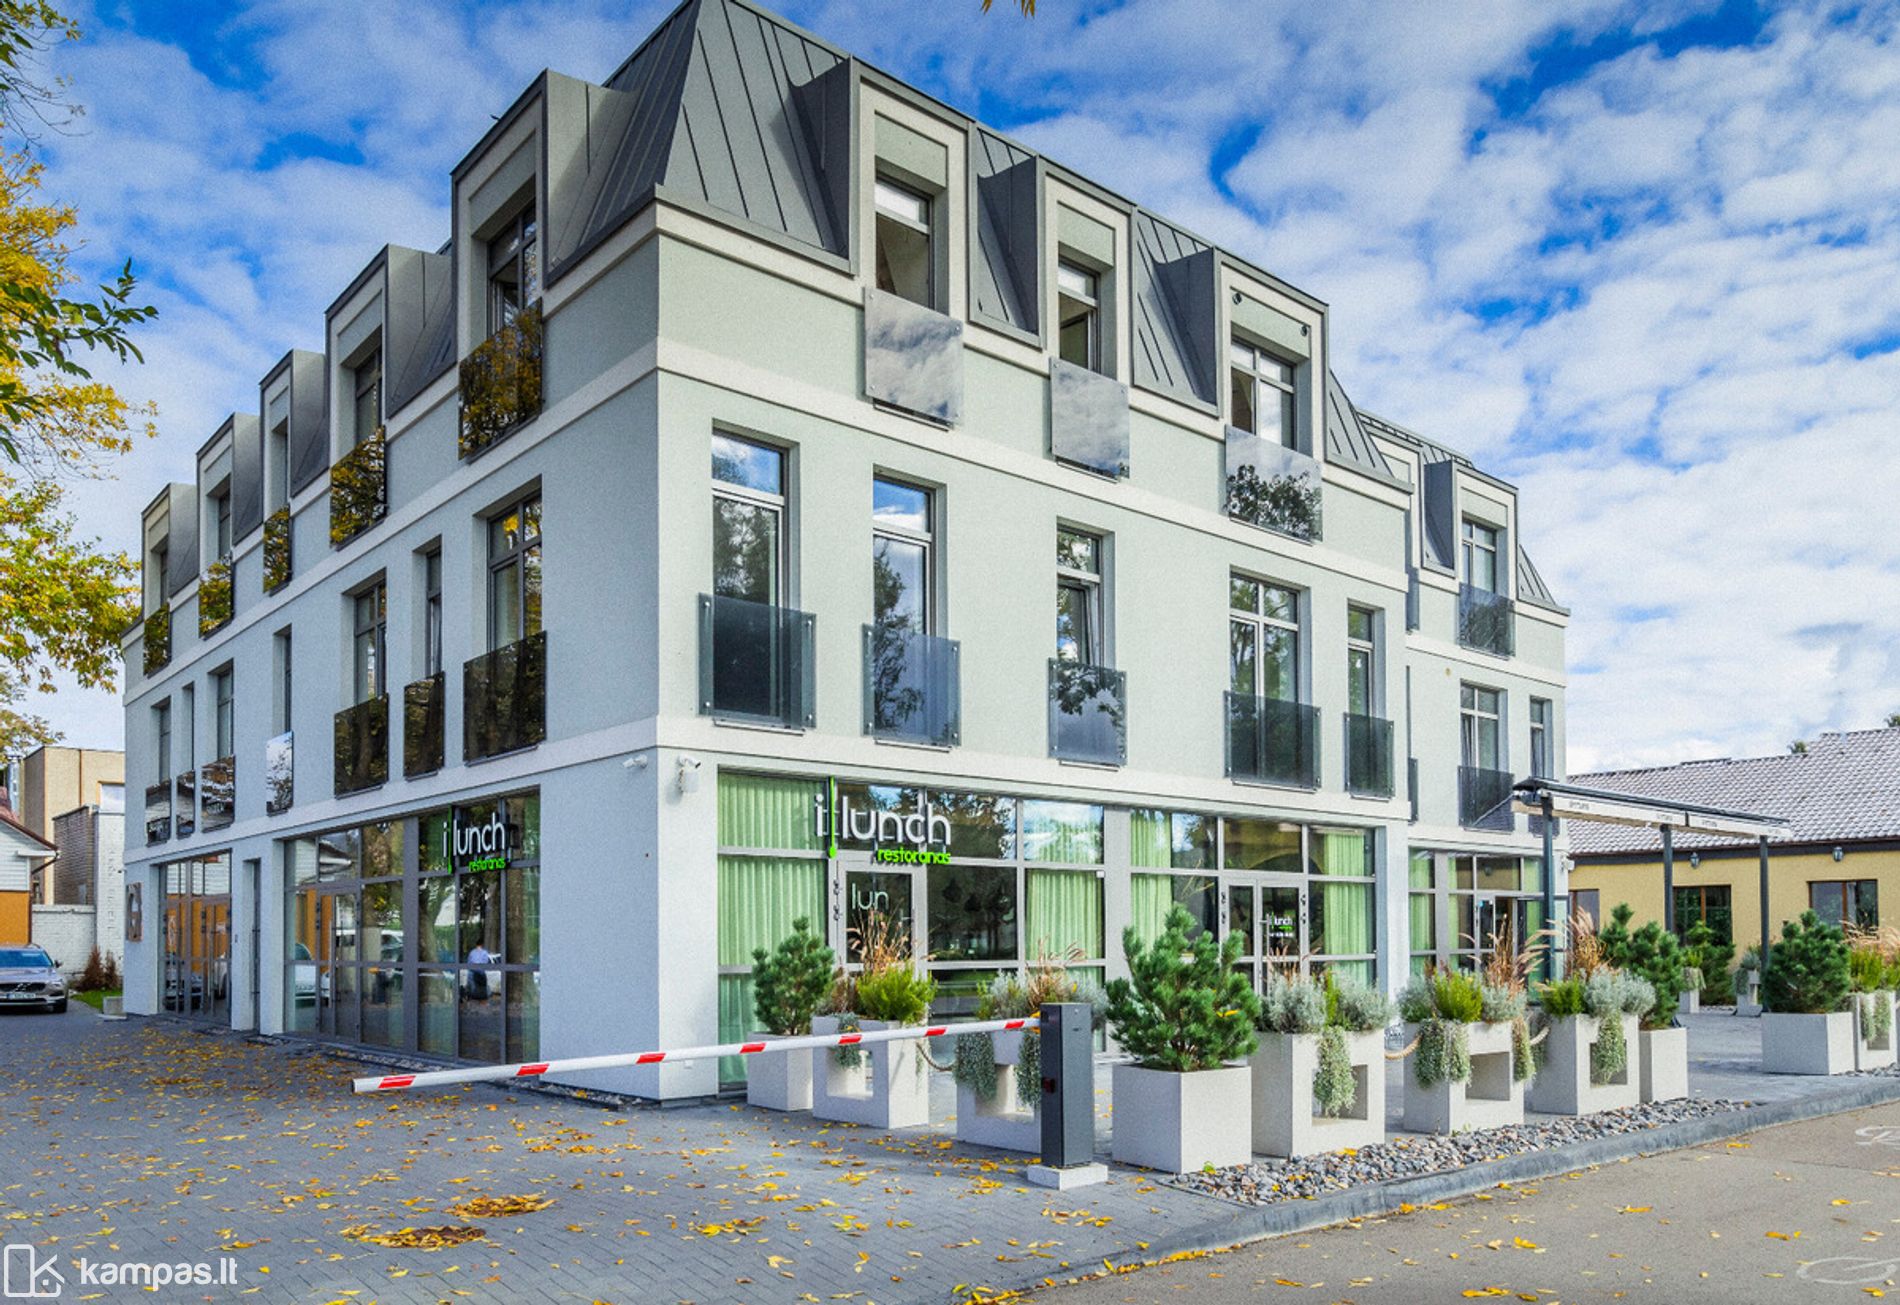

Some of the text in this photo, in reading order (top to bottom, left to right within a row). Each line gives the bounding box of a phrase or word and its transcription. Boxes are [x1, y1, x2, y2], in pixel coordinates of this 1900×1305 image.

[453, 811, 505, 857] lunch
[842, 795, 952, 845] lunch
[877, 847, 951, 865] restoranas
